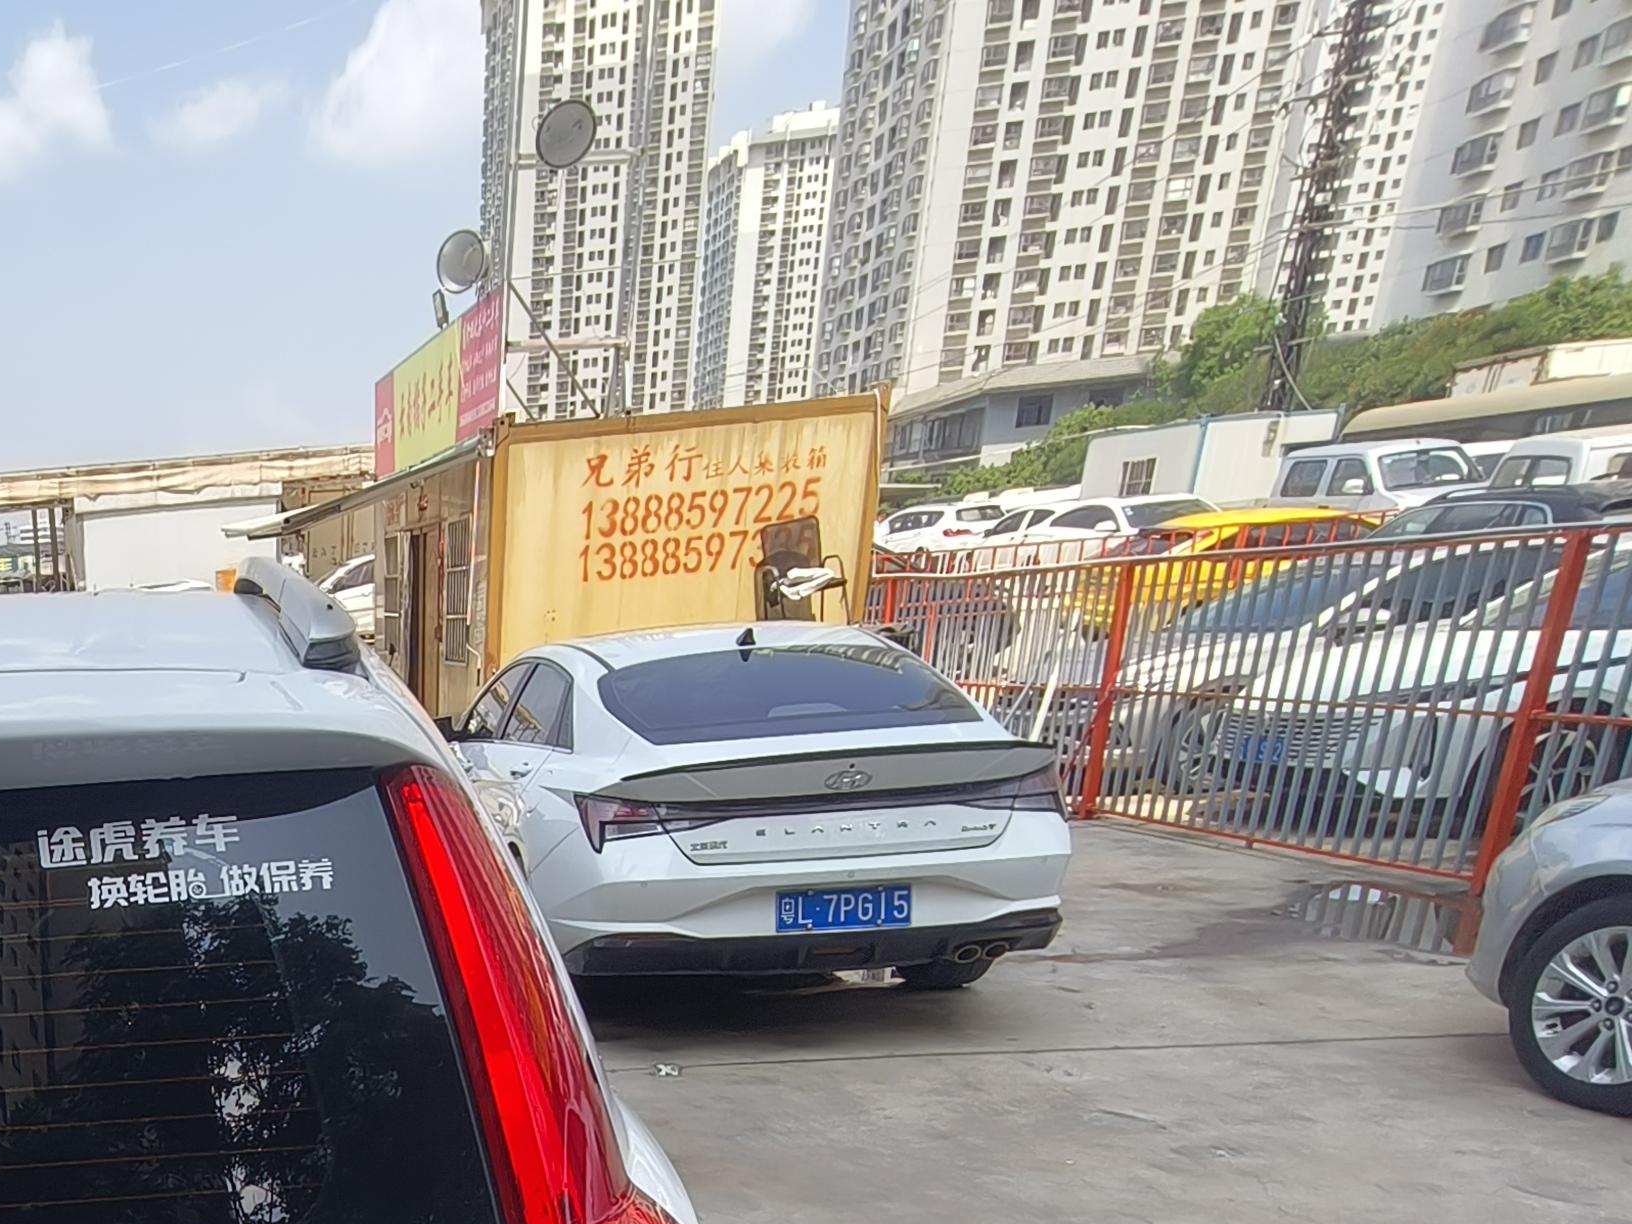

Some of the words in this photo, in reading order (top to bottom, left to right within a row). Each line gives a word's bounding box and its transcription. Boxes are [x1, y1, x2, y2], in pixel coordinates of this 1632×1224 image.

[579, 444, 703, 488] 兄弟行
[581, 476, 822, 540] 13888597225
[37, 813, 241, 869] 途虎养车
[87, 867, 208, 910] 换轮胎
[219, 857, 334, 897] 做保养
